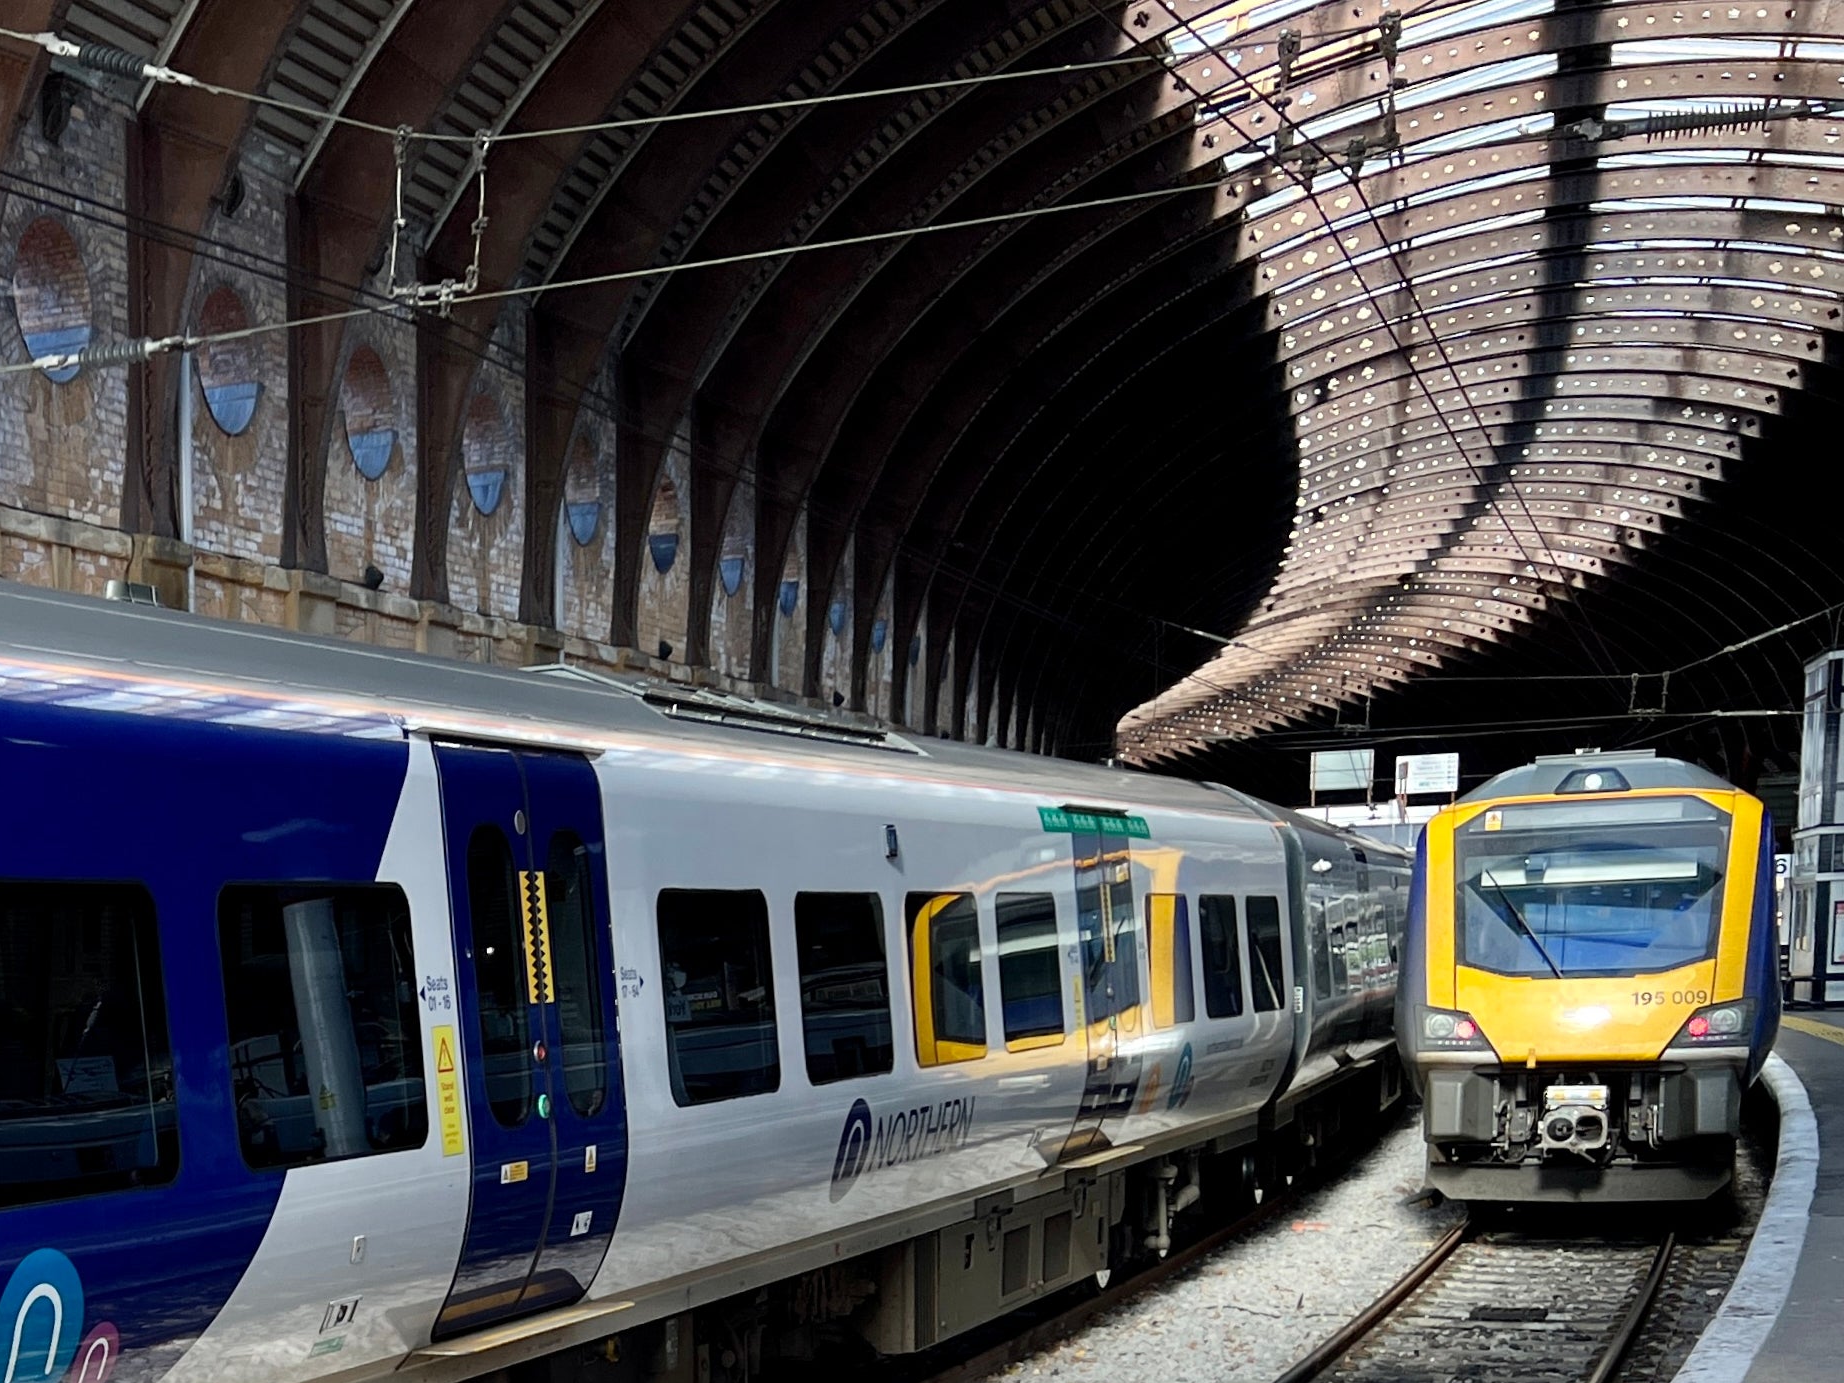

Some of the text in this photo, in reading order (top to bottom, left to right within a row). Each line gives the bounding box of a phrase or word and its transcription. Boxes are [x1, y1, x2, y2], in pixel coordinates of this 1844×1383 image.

[619, 966, 638, 981] Seats
[426, 975, 448, 992] Seats
[428, 995, 437, 1011] 01
[442, 994, 451, 1010] 16
[1631, 989, 1708, 1006] 195 009
[867, 1096, 976, 1173] NORTHERN
